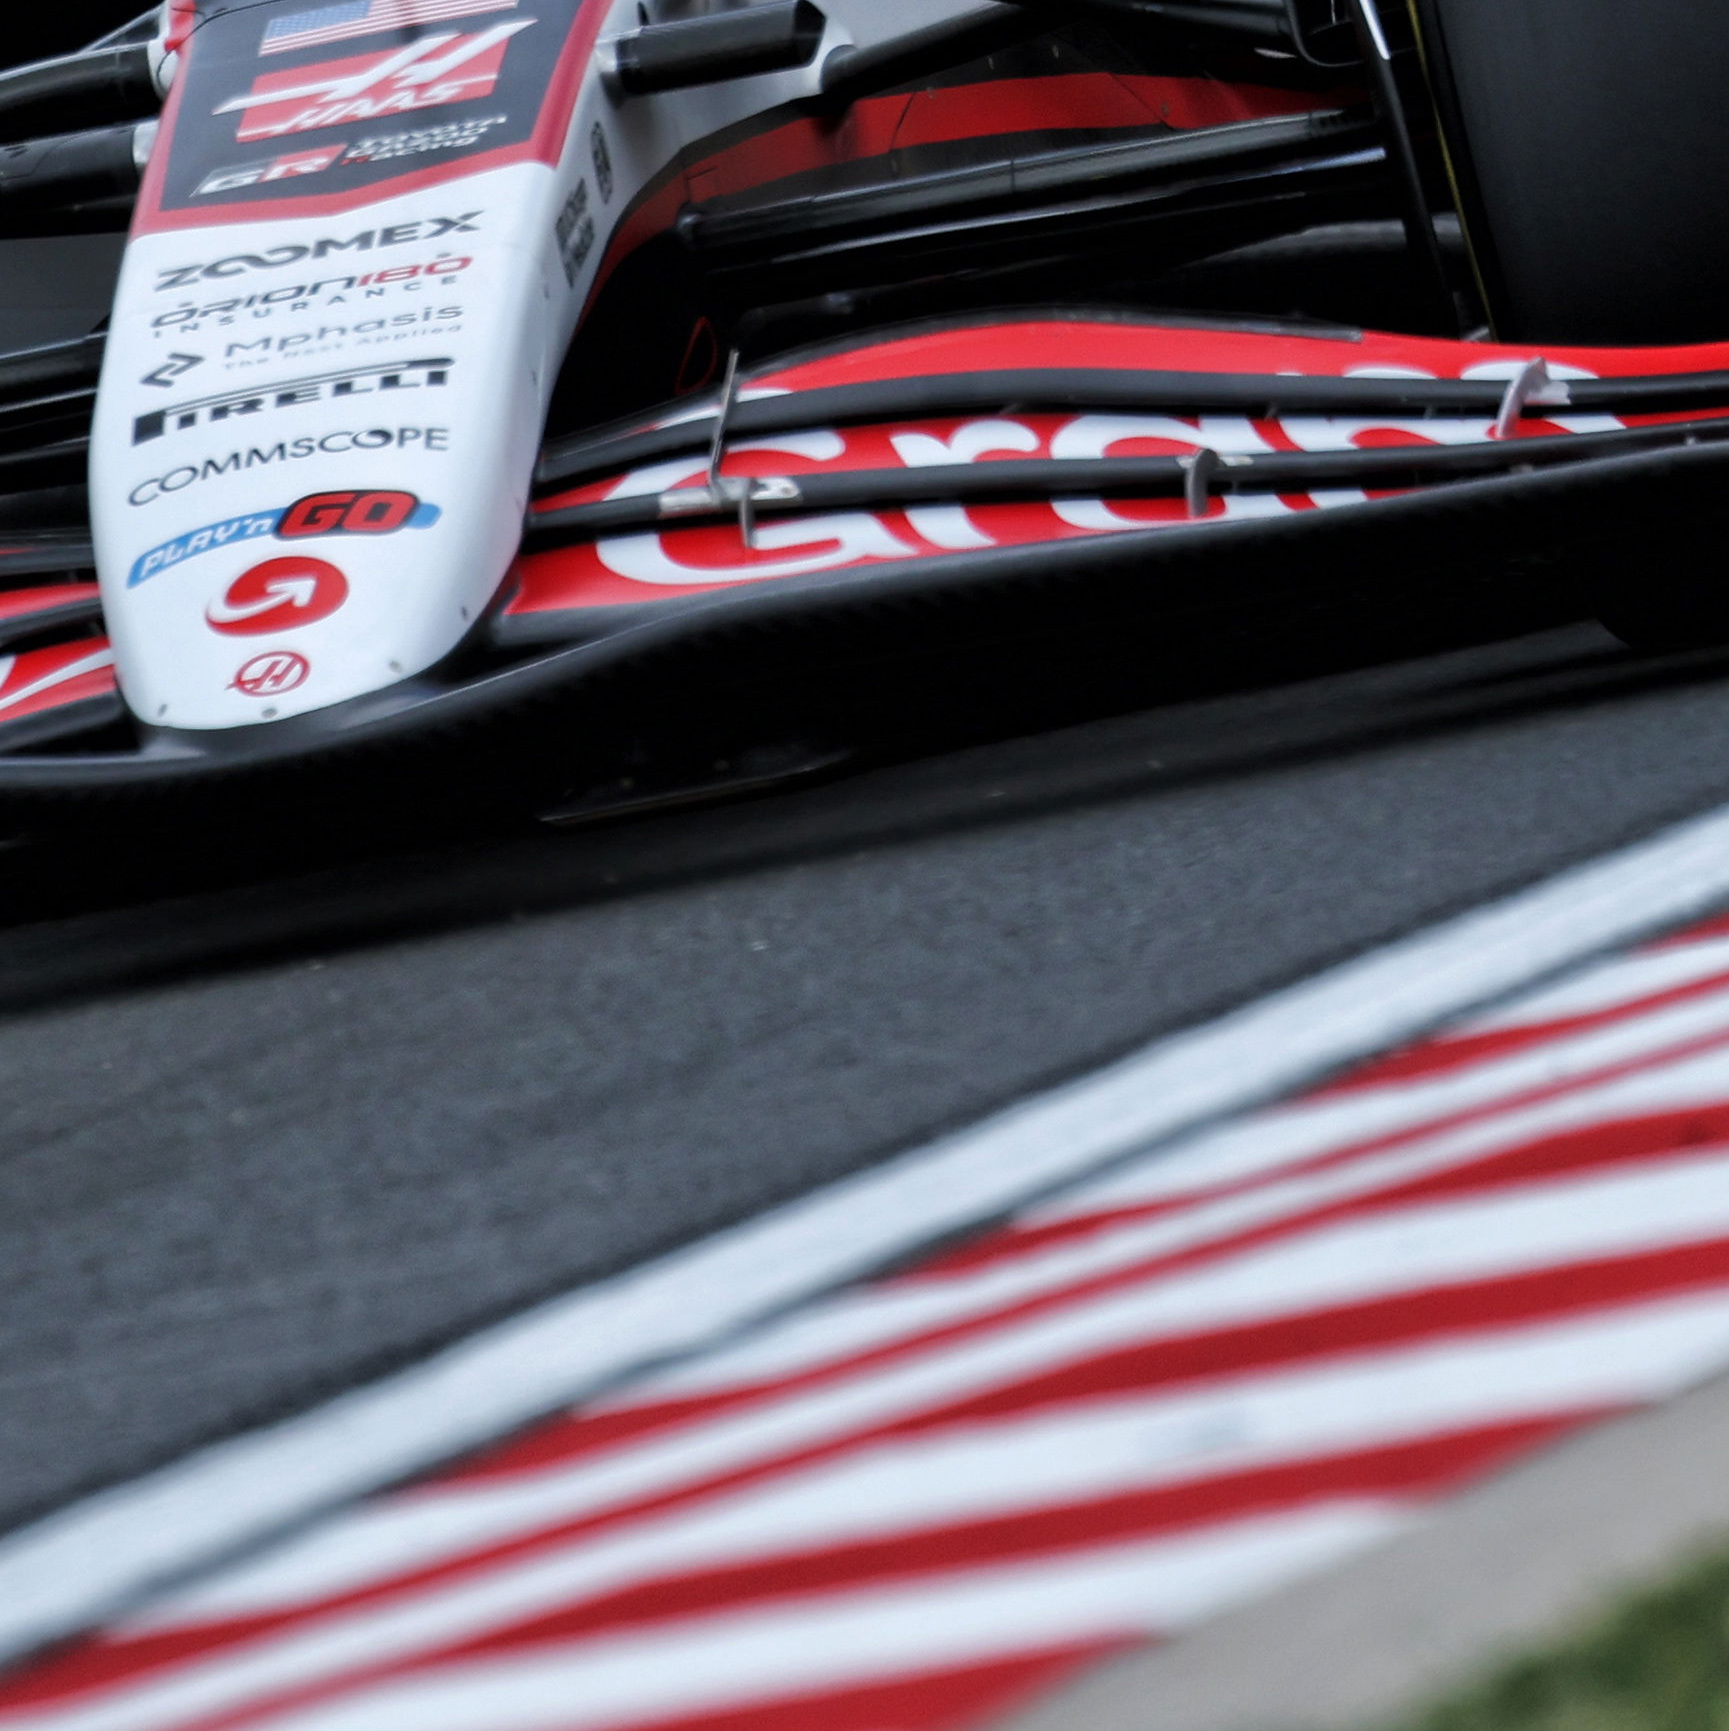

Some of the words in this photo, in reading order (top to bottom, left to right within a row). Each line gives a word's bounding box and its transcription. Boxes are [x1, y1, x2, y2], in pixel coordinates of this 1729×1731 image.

[153, 210, 484, 293] ZOOMEX
[154, 274, 457, 339] INSURANCE
[225, 305, 464, 357] Mphasis
[131, 358, 455, 447] PIRELLI
[127, 427, 450, 507] COMMSCOPE
[277, 490, 420, 539] GO
